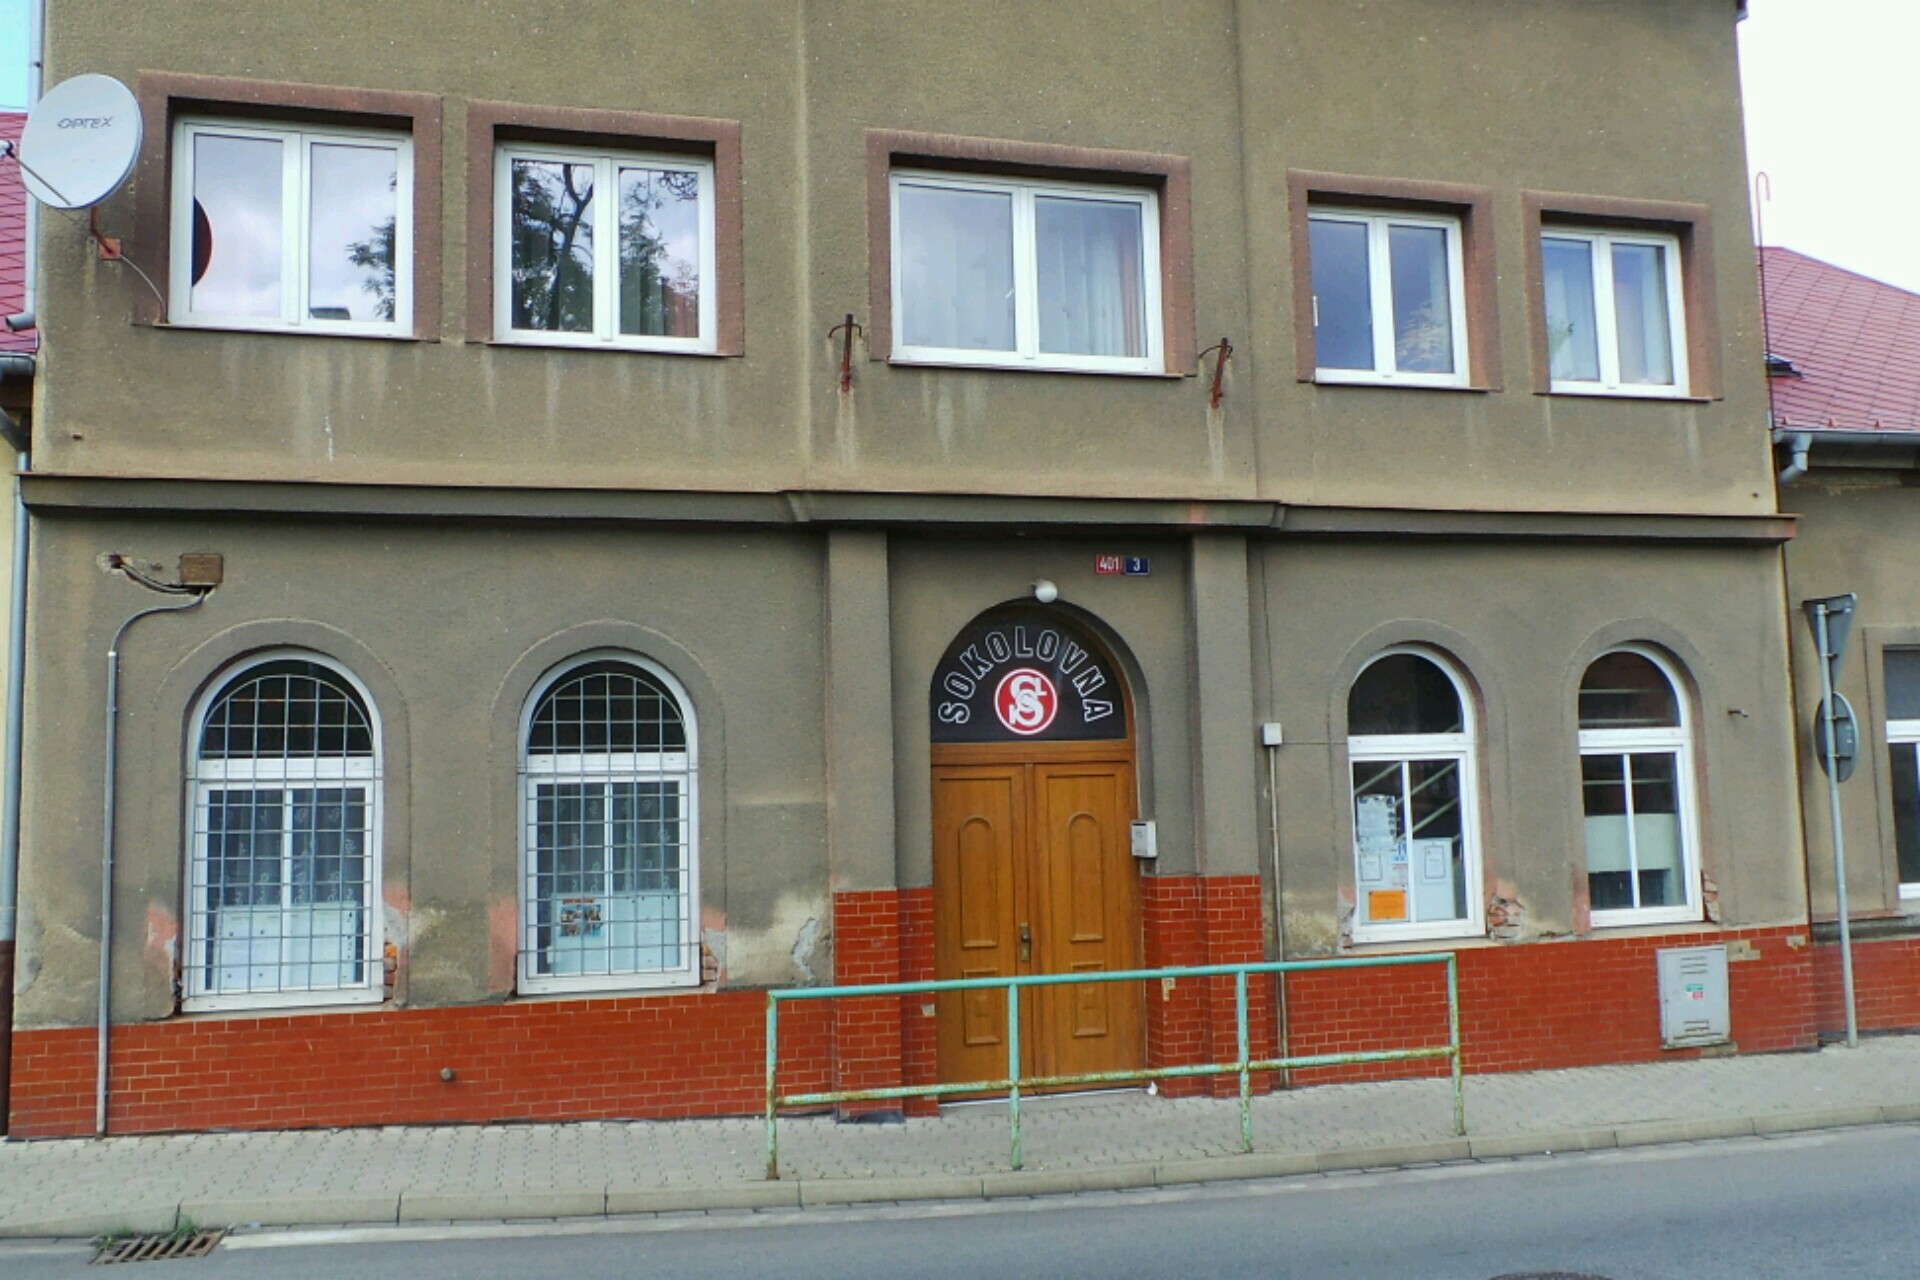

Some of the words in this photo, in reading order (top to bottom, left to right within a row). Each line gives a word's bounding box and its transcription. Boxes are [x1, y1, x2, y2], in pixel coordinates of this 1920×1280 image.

[57, 116, 113, 129] OPTEX
[1100, 556, 1119, 571] 401
[1133, 557, 1141, 571] 3
[938, 626, 1113, 724] SOKOLOVNA
